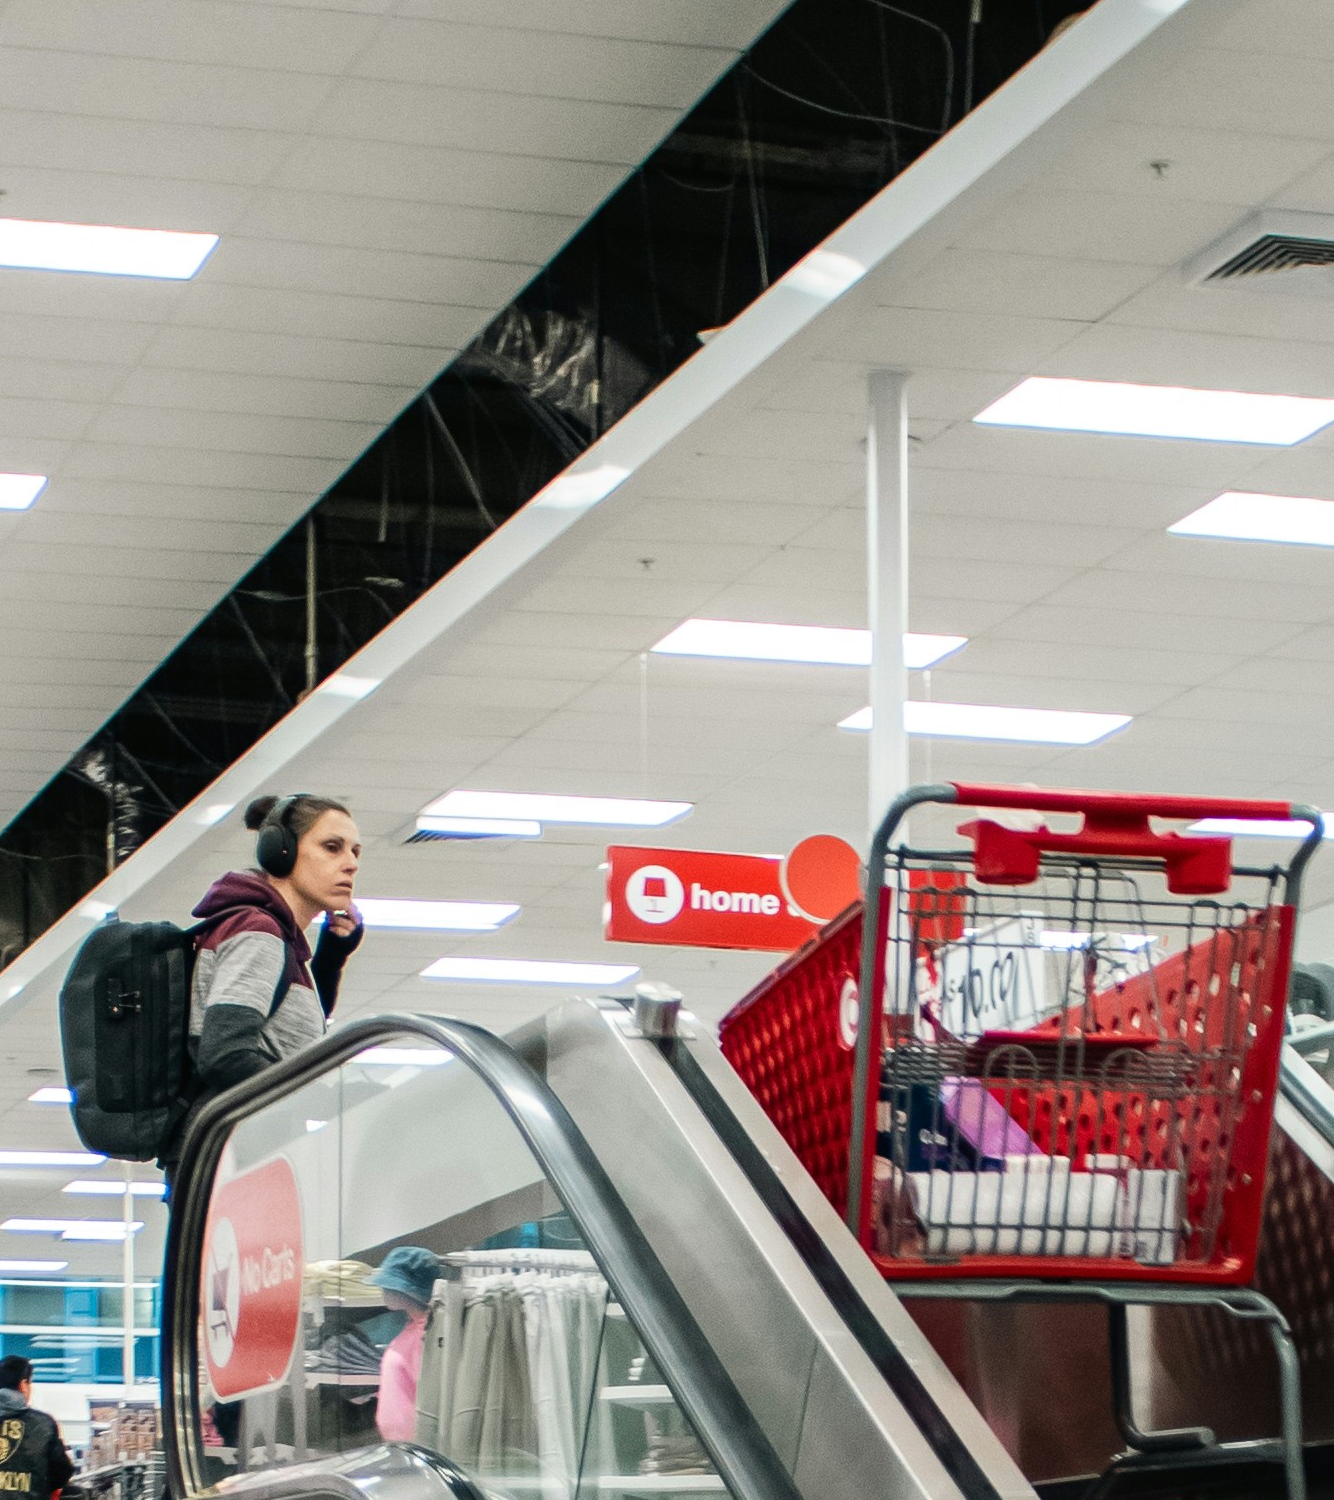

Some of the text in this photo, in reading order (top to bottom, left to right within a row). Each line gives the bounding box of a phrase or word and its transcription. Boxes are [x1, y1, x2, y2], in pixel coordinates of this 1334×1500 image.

[690, 883, 781, 916] home
[241, 1244, 295, 1296] No Carts
